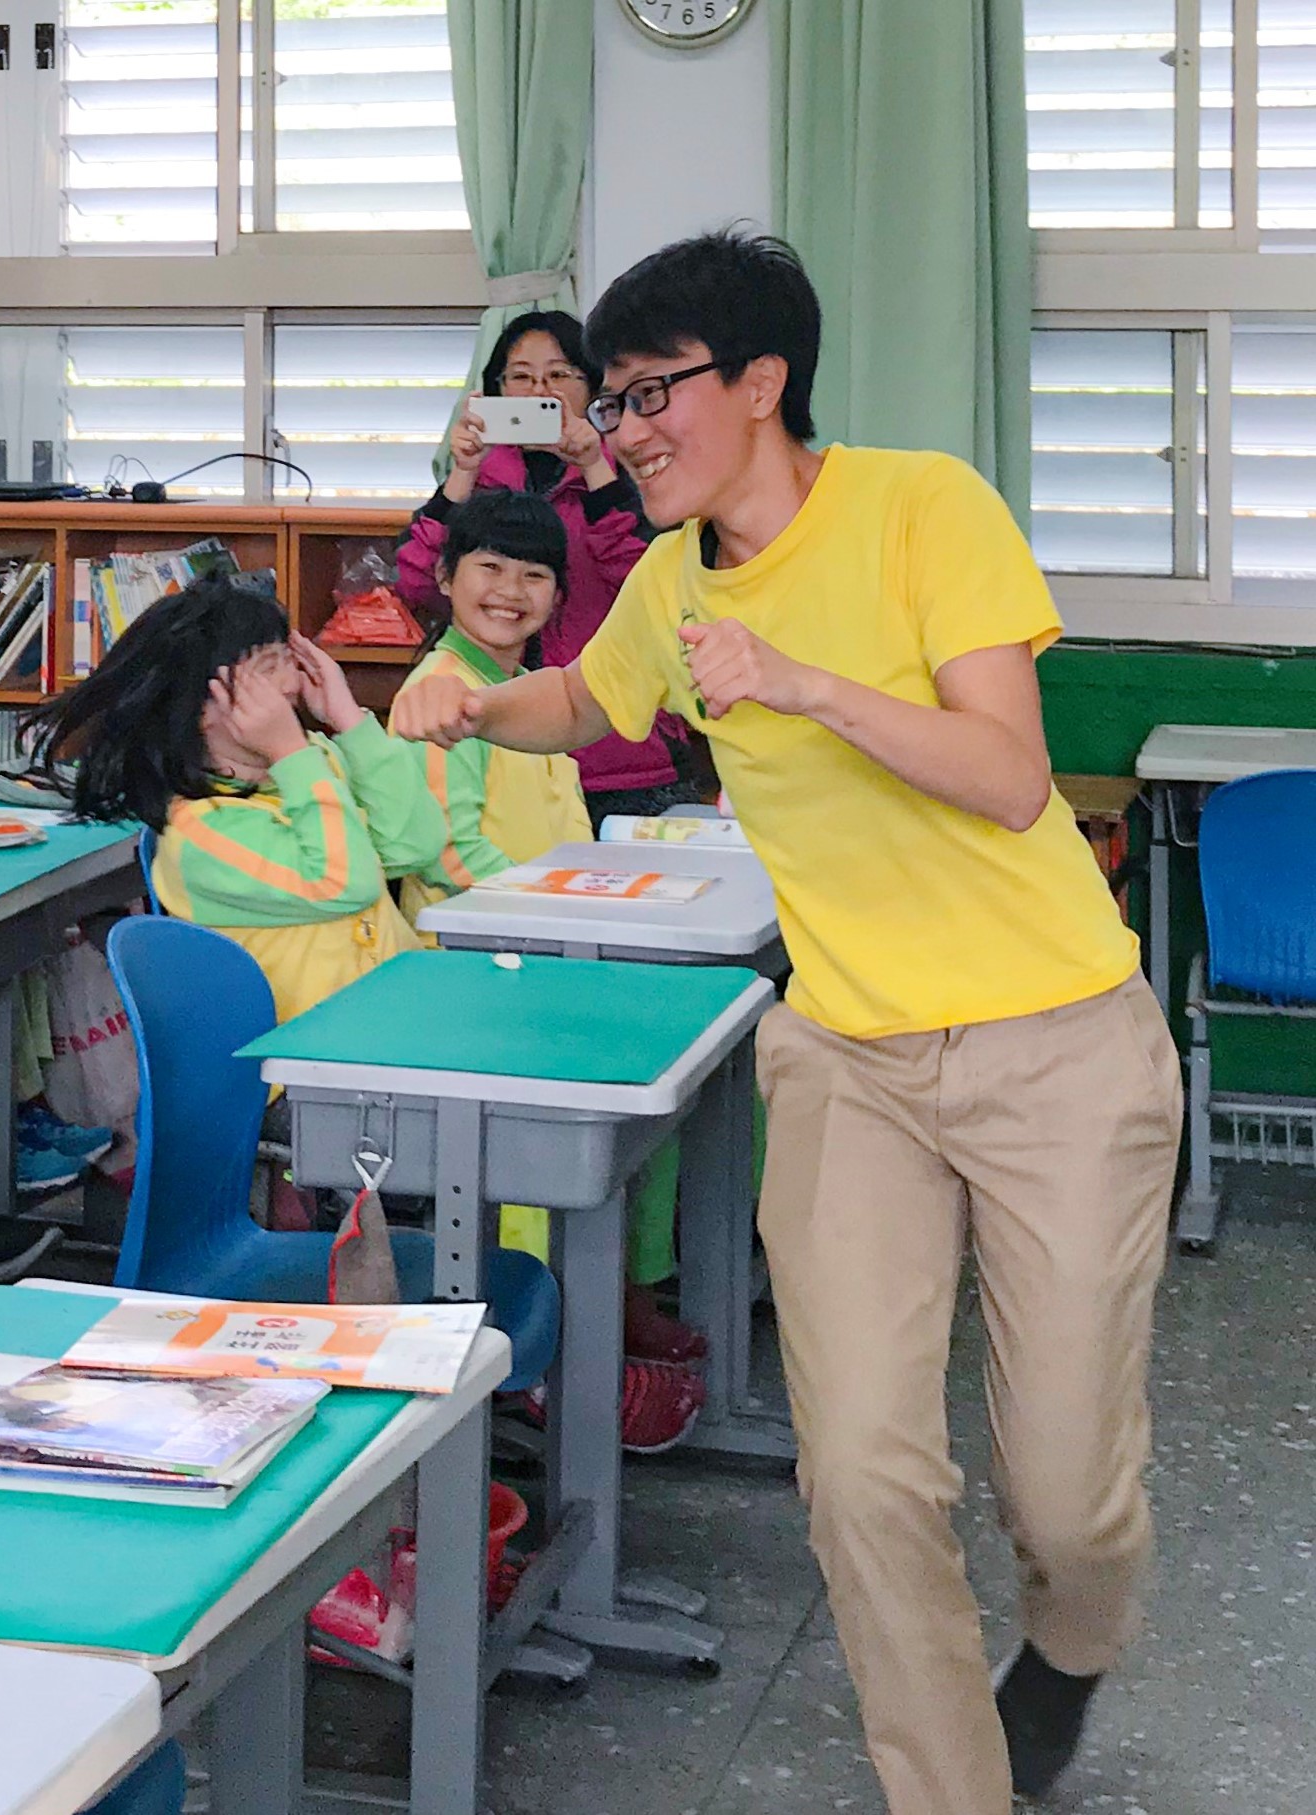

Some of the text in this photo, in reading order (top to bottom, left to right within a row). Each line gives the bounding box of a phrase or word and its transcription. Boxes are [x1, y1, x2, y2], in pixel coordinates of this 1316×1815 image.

[661, 4, 672, 19] 7
[682, 8, 695, 25] 6
[704, 2, 715, 18] 5
